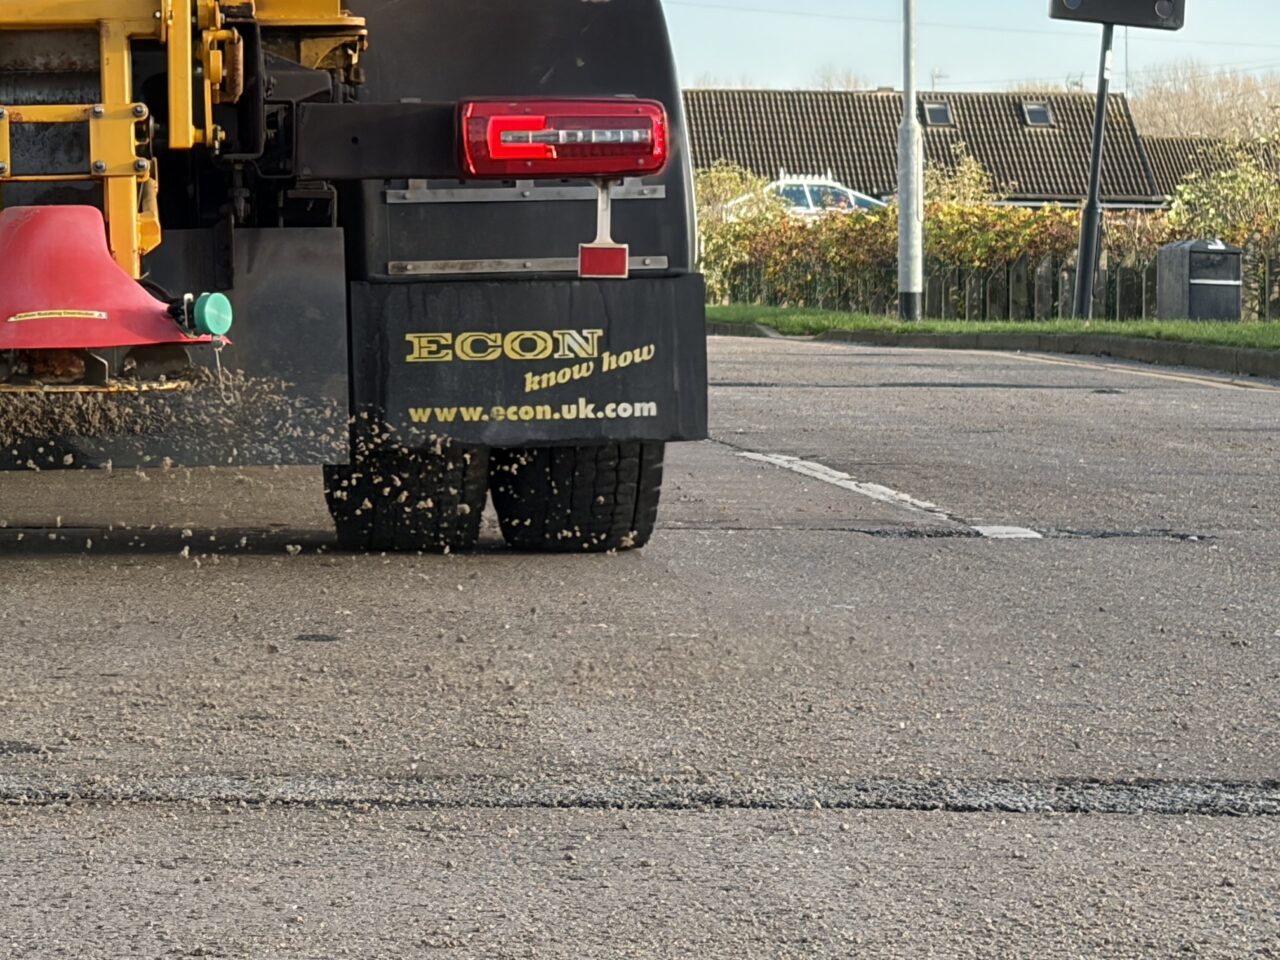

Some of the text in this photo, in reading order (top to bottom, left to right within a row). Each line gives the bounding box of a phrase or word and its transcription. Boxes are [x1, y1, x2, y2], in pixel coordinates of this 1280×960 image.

[405, 329, 603, 362] ECON
[524, 344, 655, 392] know how
[408, 398, 658, 423] www.econ.uk.com
